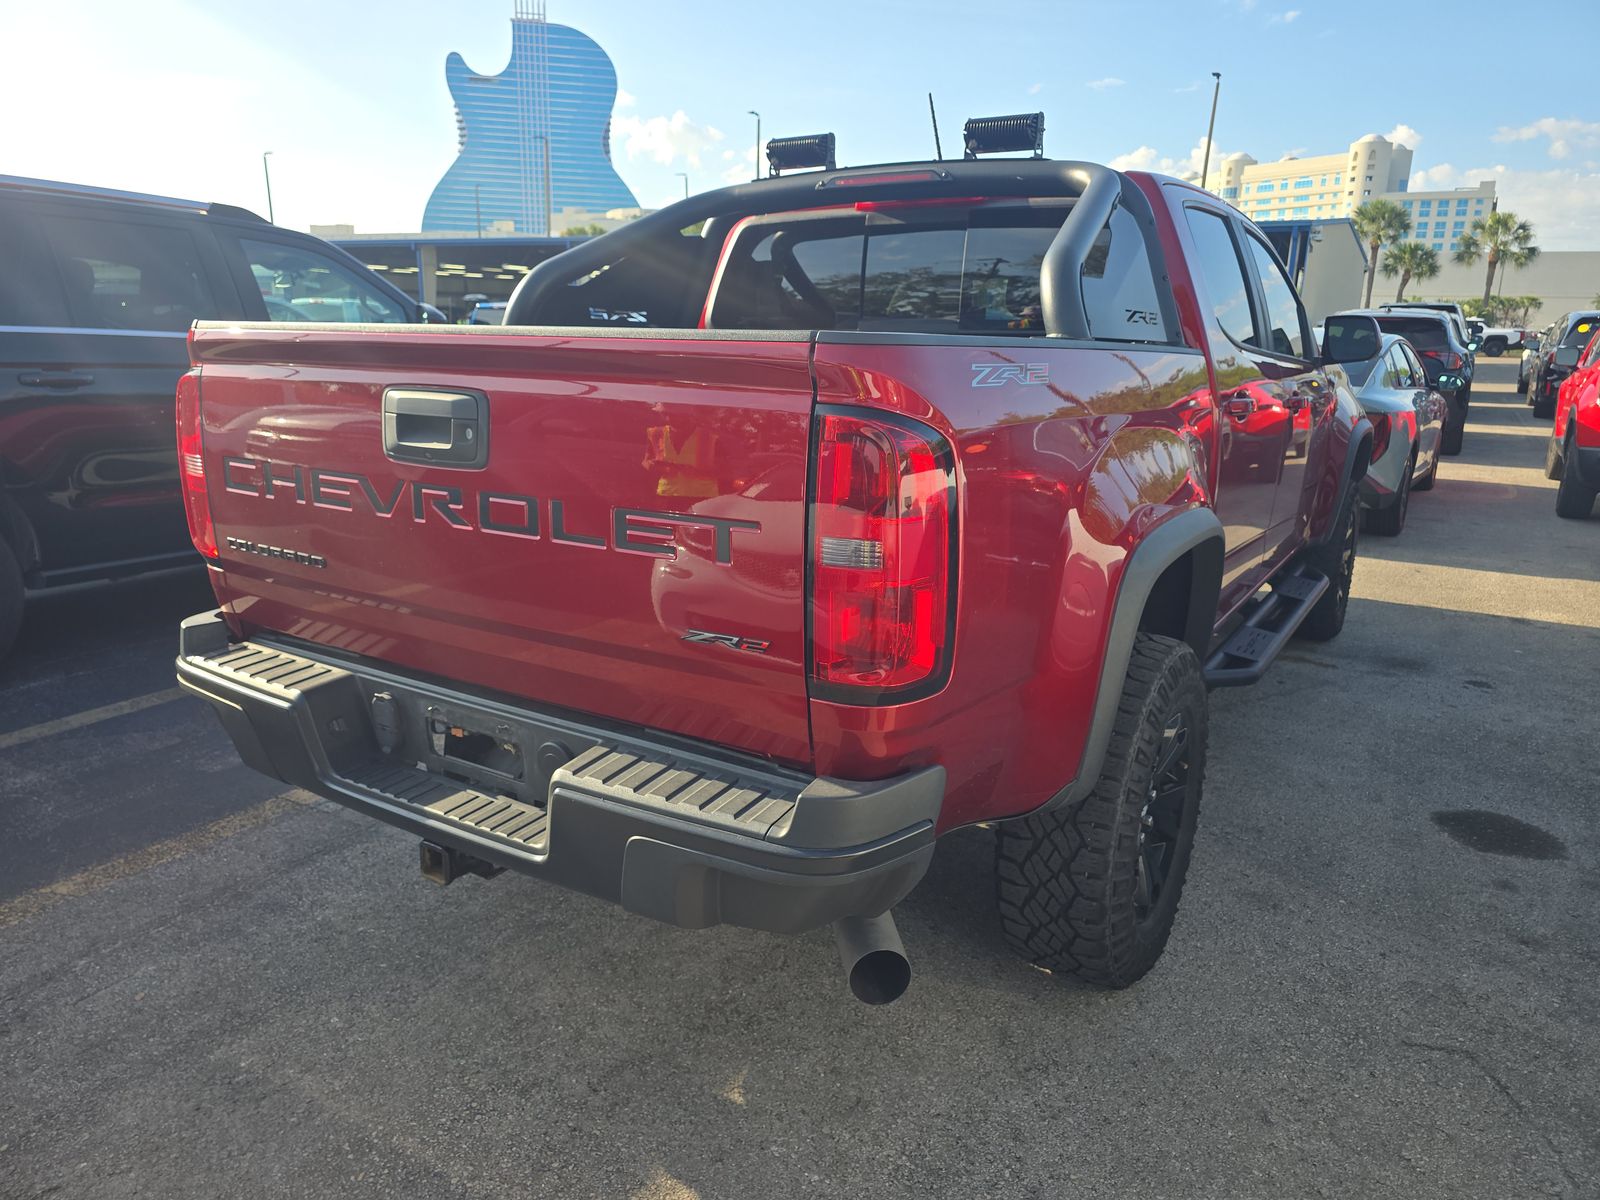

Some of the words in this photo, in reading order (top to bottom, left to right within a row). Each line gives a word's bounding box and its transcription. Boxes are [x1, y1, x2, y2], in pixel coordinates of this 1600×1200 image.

[1125, 309, 1158, 325] ZR2
[971, 362, 1050, 387] ZR2
[223, 455, 762, 568] CHEVROLET
[226, 536, 327, 569] COLORADO
[681, 628, 771, 653] ZR2
